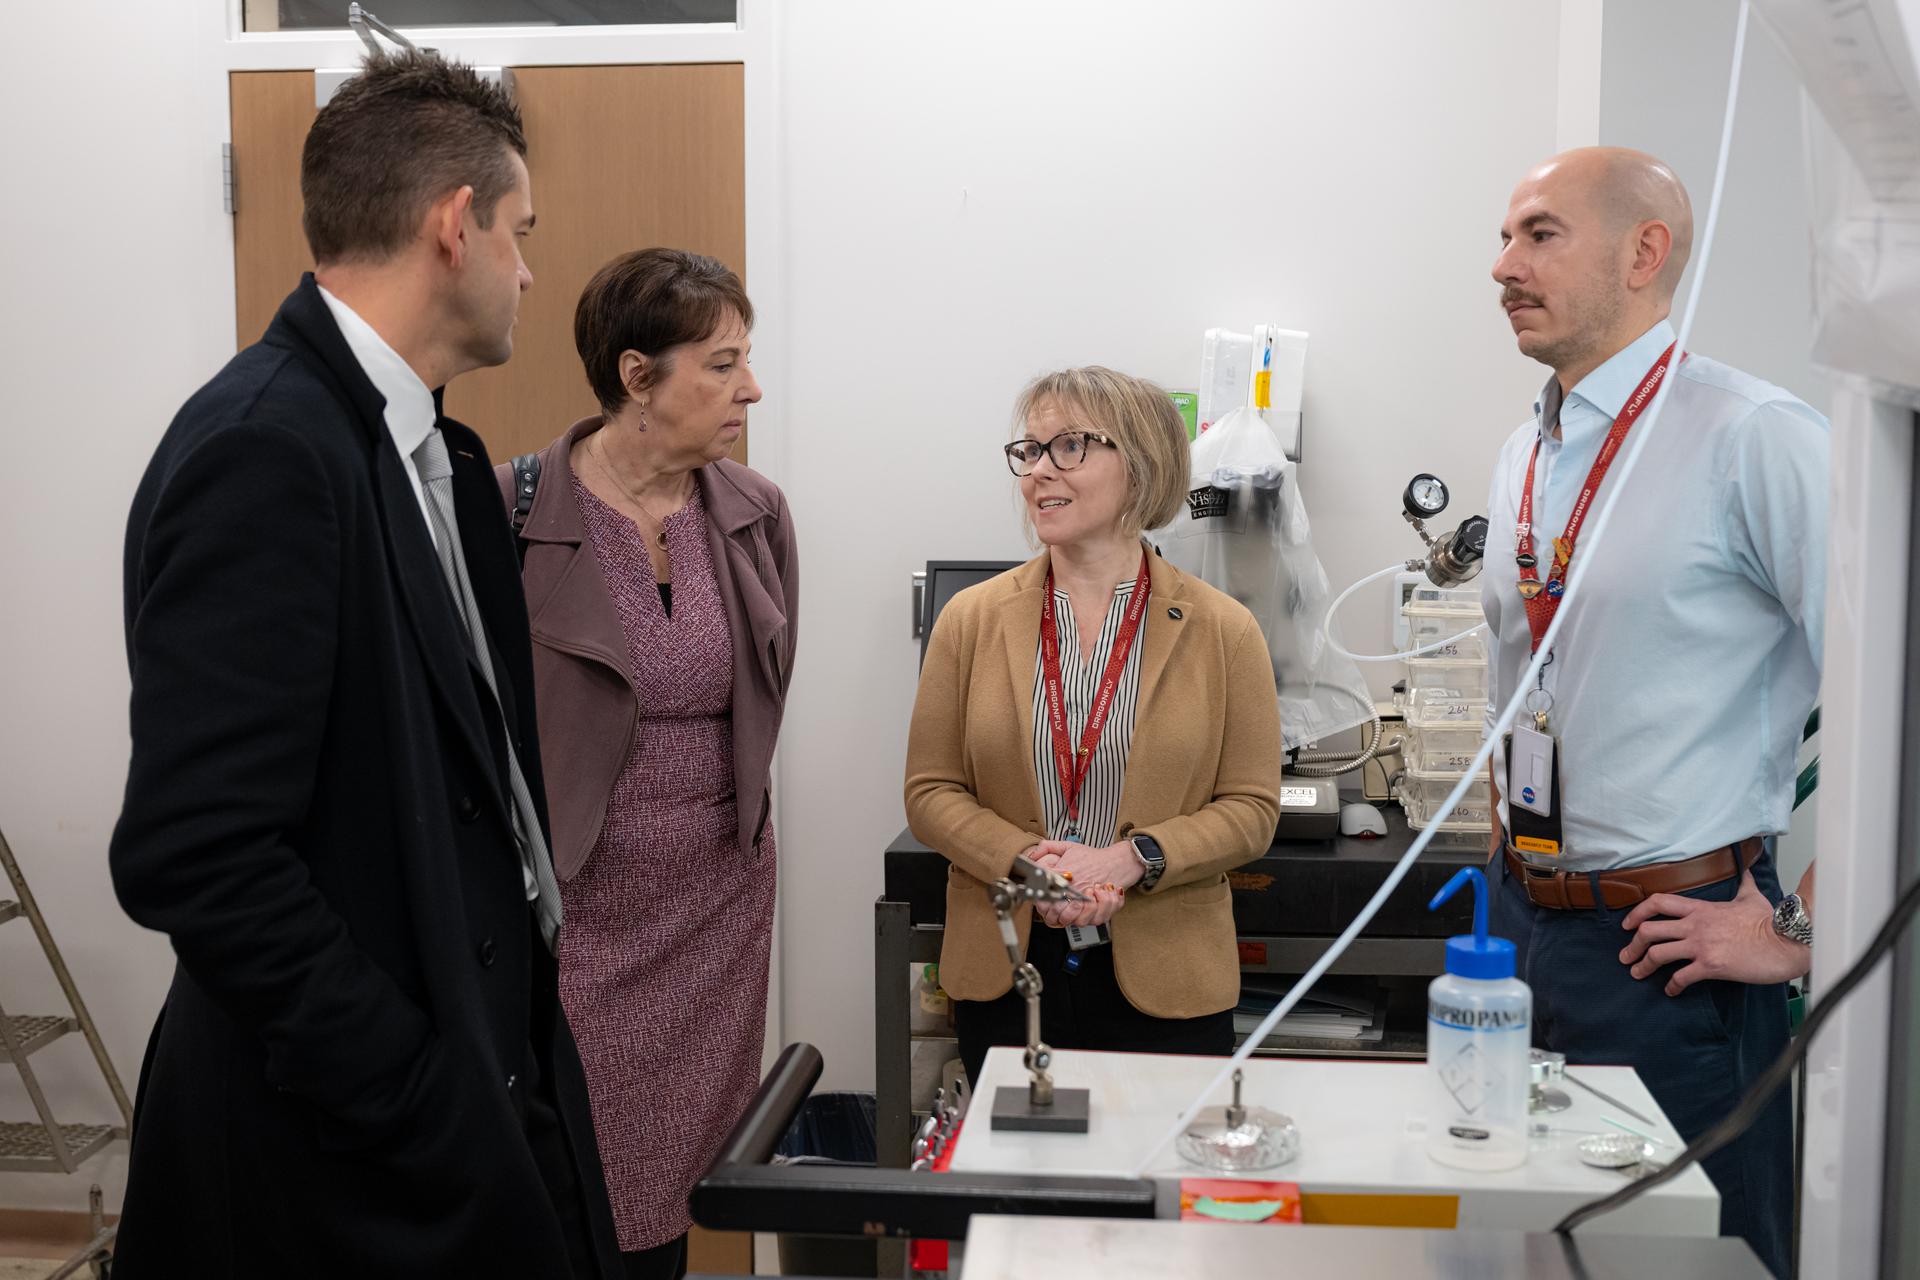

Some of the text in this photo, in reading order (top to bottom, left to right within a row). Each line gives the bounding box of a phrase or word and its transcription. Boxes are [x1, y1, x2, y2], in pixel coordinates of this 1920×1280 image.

[1627, 365, 1666, 416] DRAGONFLY
[1130, 575, 1150, 621] DRAGONFLY
[1049, 679, 1063, 732] DRAGONFLY
[1091, 678, 1114, 730] DRAGONFLY
[1448, 705, 1469, 715] 264
[1449, 757, 1471, 766] 258
